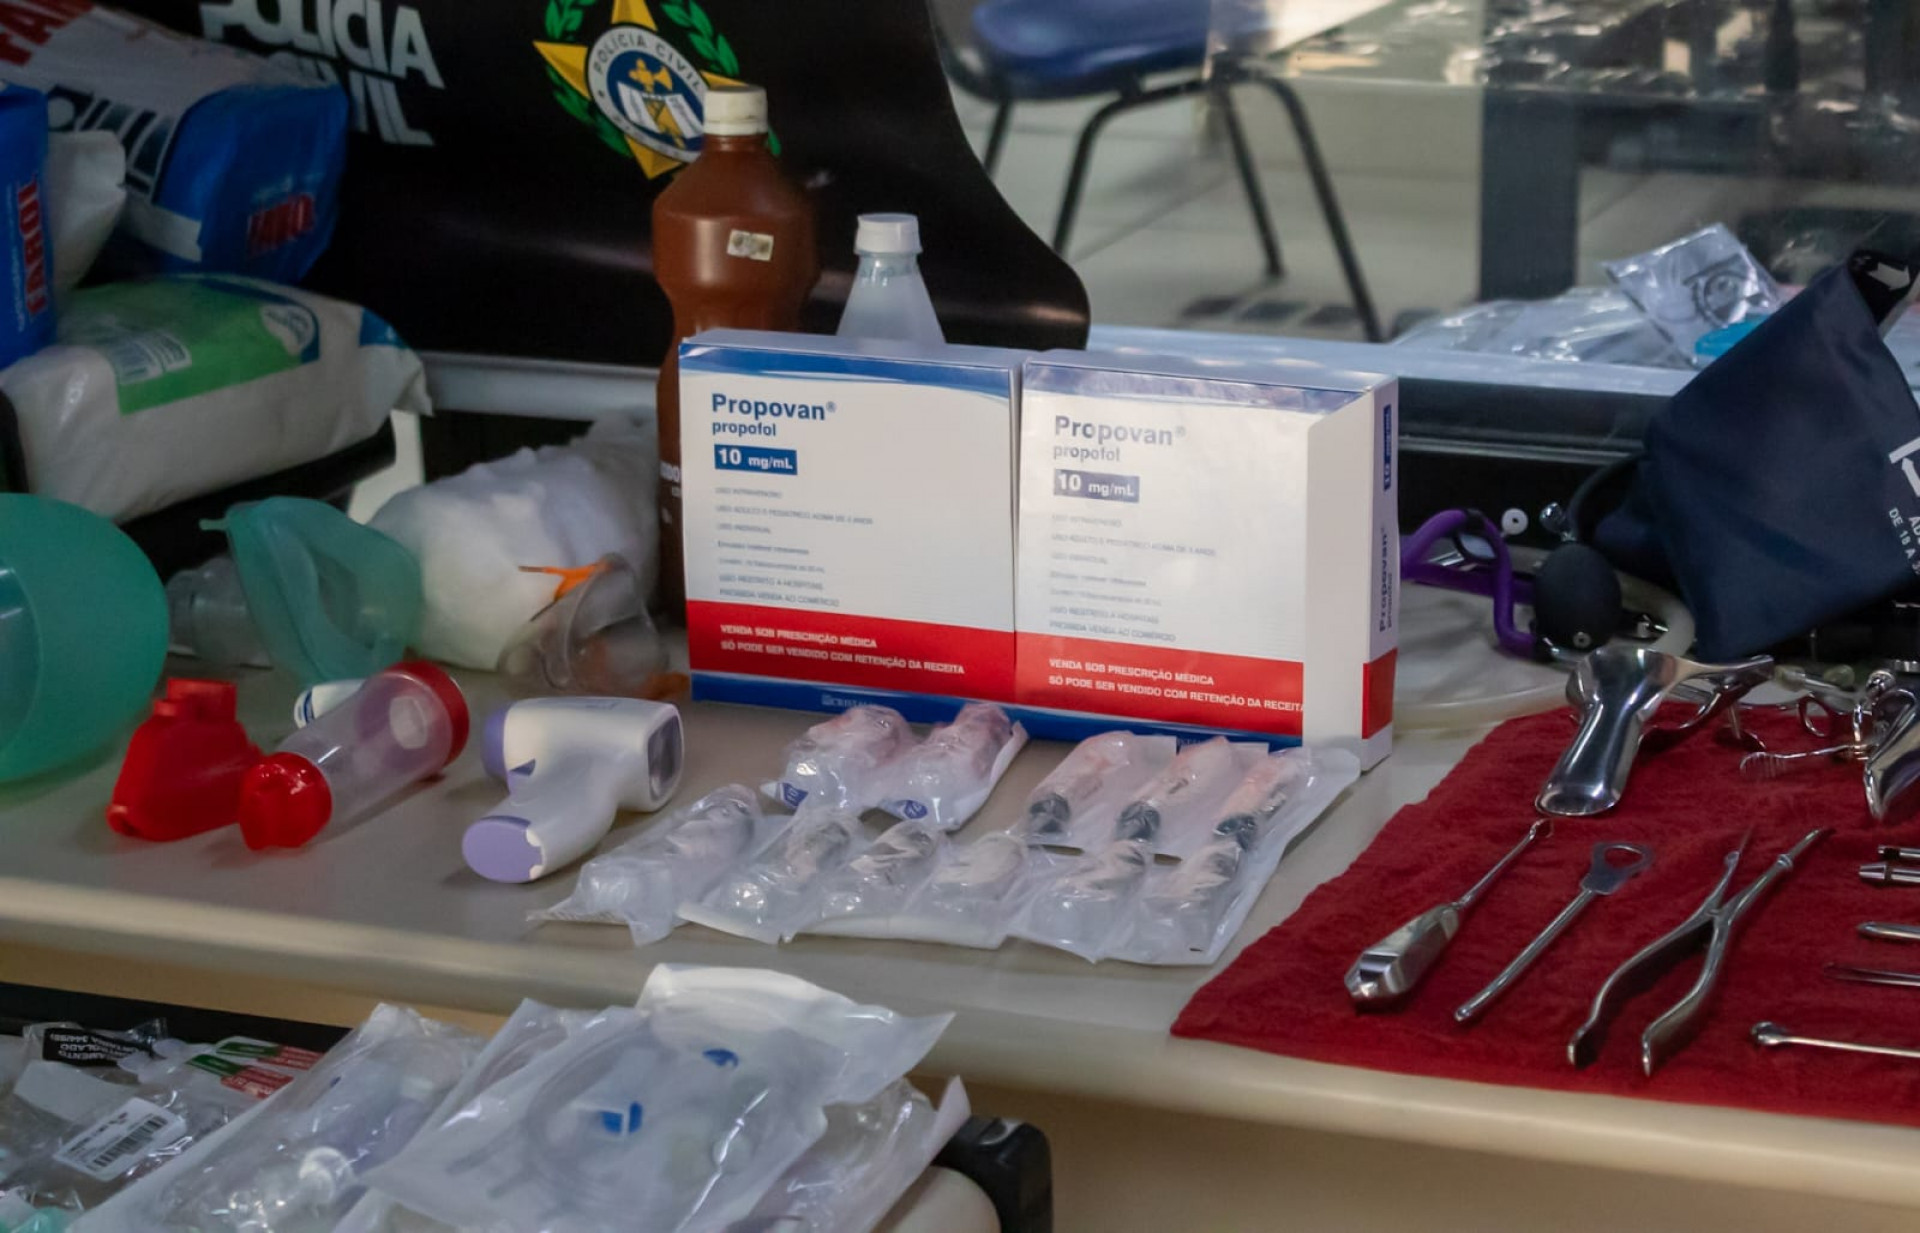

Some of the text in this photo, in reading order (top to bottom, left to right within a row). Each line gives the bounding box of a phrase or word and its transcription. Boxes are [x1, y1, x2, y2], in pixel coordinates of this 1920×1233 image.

[655, 43, 701, 89] CIVIL
[712, 421, 776, 437] propofol
[718, 448, 793, 470] 10 mg/mL
[1053, 446, 1120, 462] propofol
[1058, 473, 1135, 497] 10 mg/mL
[1888, 507, 1904, 528] DE
[1899, 530, 1912, 546] 18
[1904, 548, 1917, 560] A
[720, 623, 753, 636] VENDA
[754, 627, 775, 638] SOB
[776, 629, 837, 646] PRESCRIÇÃO
[737, 641, 763, 654] PODE
[765, 644, 784, 656] SER
[785, 646, 828, 661] VENDIDO
[829, 650, 852, 662] COM
[854, 652, 905, 669] RETENÇÃO
[907, 658, 921, 670] DA
[923, 660, 965, 675] RECEITA
[1049, 658, 1082, 670] VENDA
[1084, 662, 1105, 673] SOB
[1107, 664, 1172, 681] PRESCRIÇÃO
[1064, 676, 1092, 689] PODE
[1095, 680, 1115, 692] SER
[1116, 682, 1161, 697] VENDIDO
[1163, 687, 1187, 700] COM
[1189, 690, 1244, 706] RETENÇÃO
[1247, 697, 1261, 708] DA
